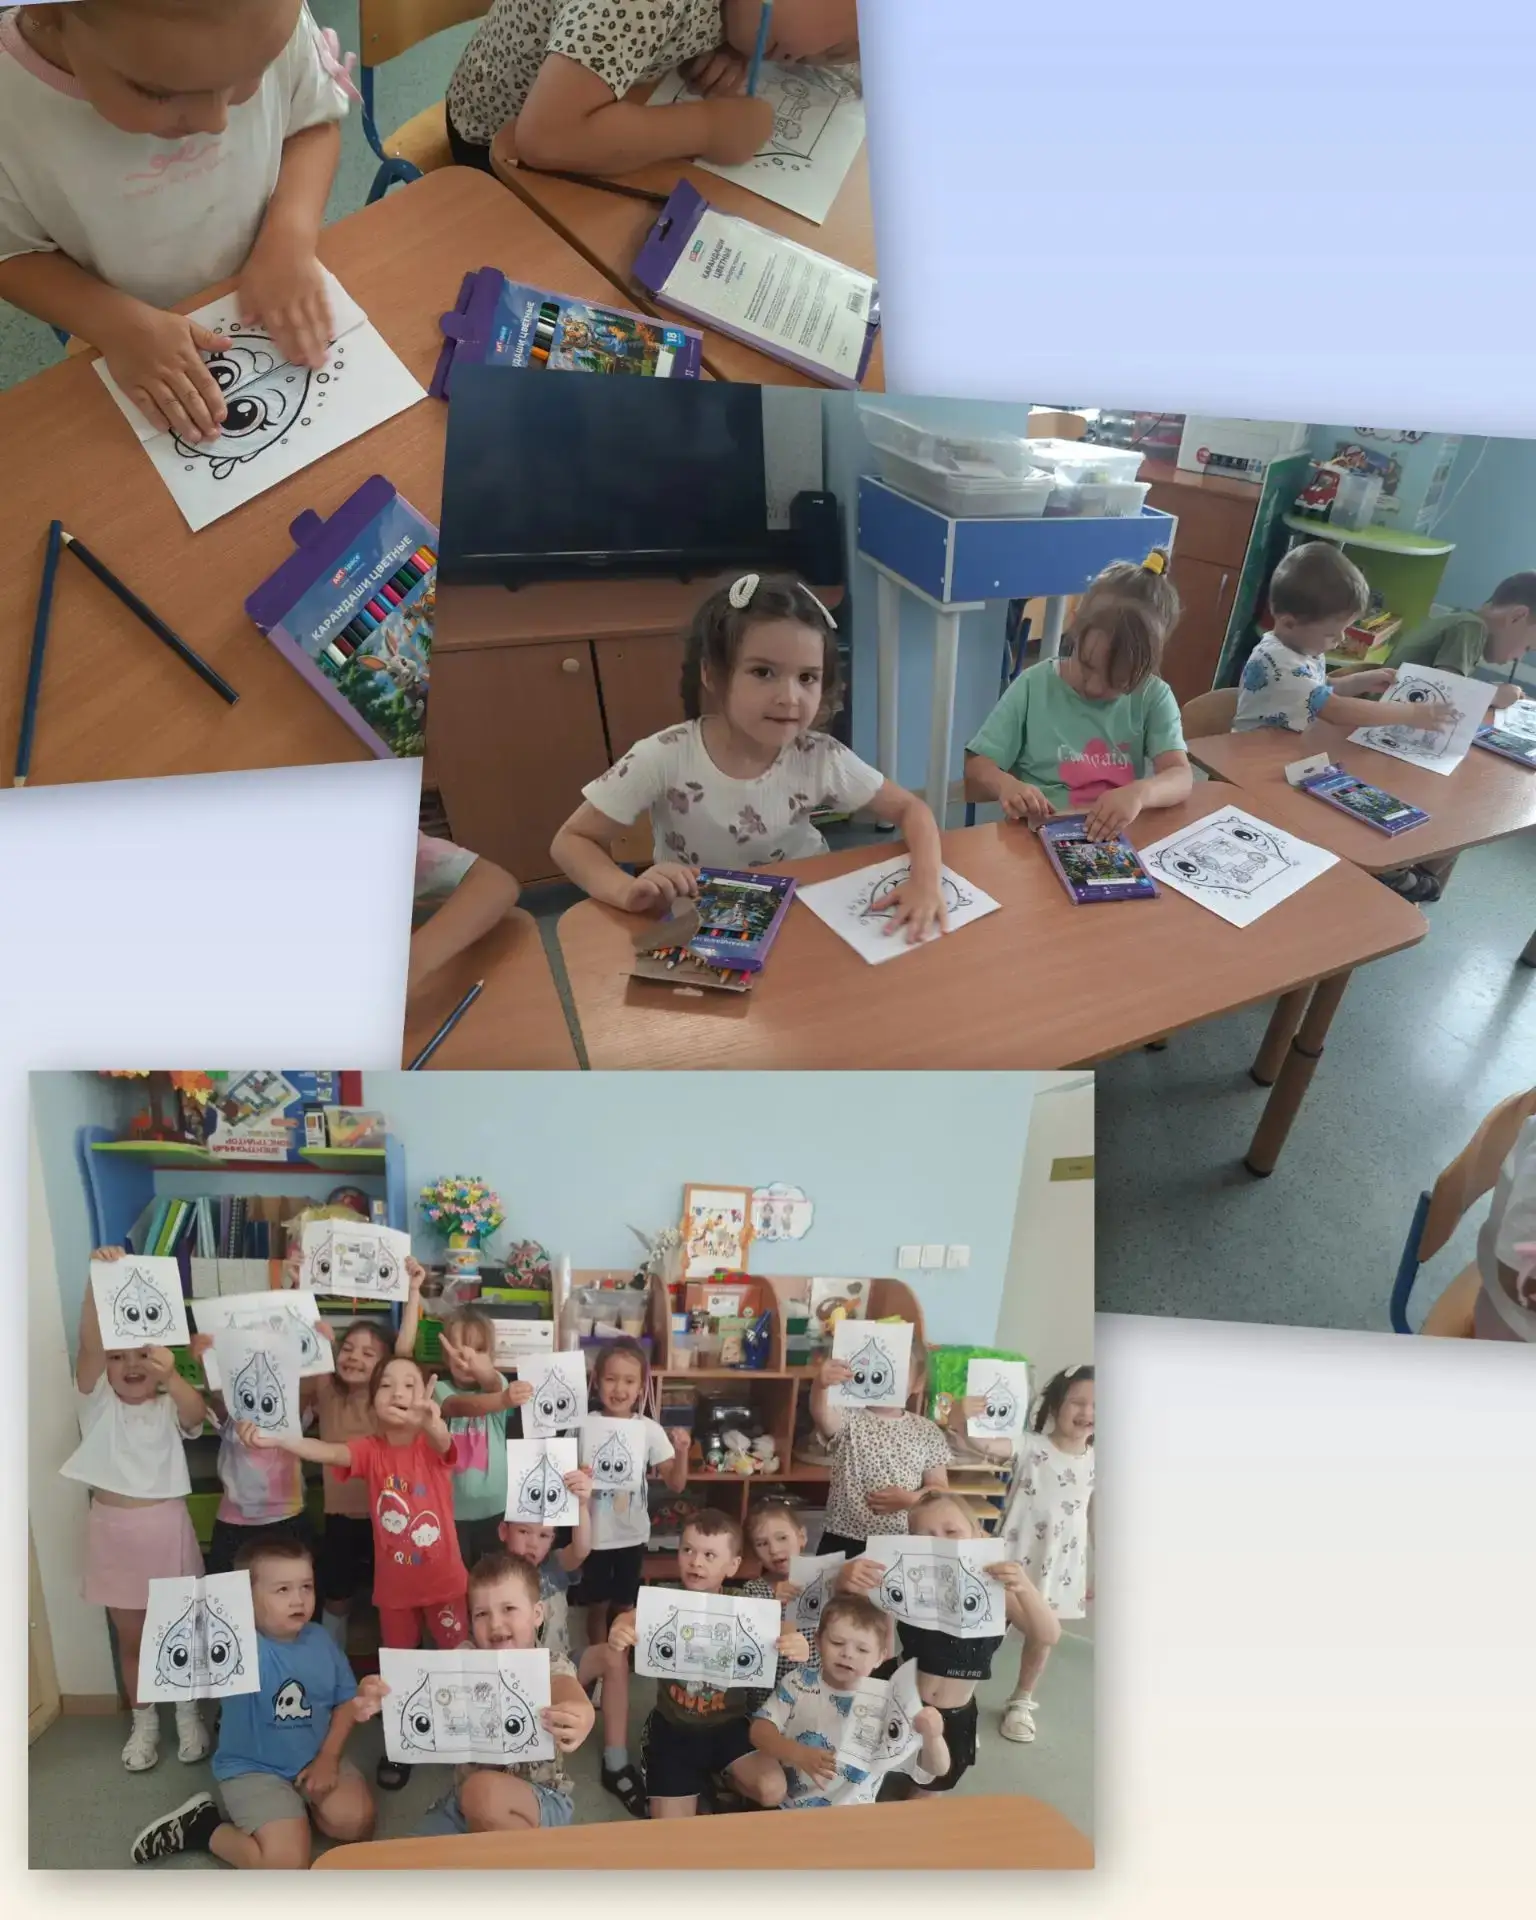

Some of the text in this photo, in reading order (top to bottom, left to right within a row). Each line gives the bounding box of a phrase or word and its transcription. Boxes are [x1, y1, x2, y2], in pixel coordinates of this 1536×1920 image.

[520, 301, 535, 338] ЦВЕТНЫЕ
[665, 331, 678, 343] 18
[311, 578, 372, 641] КАРАНДАШИ
[369, 535, 413, 582] ЦВЕТНЫЕ
